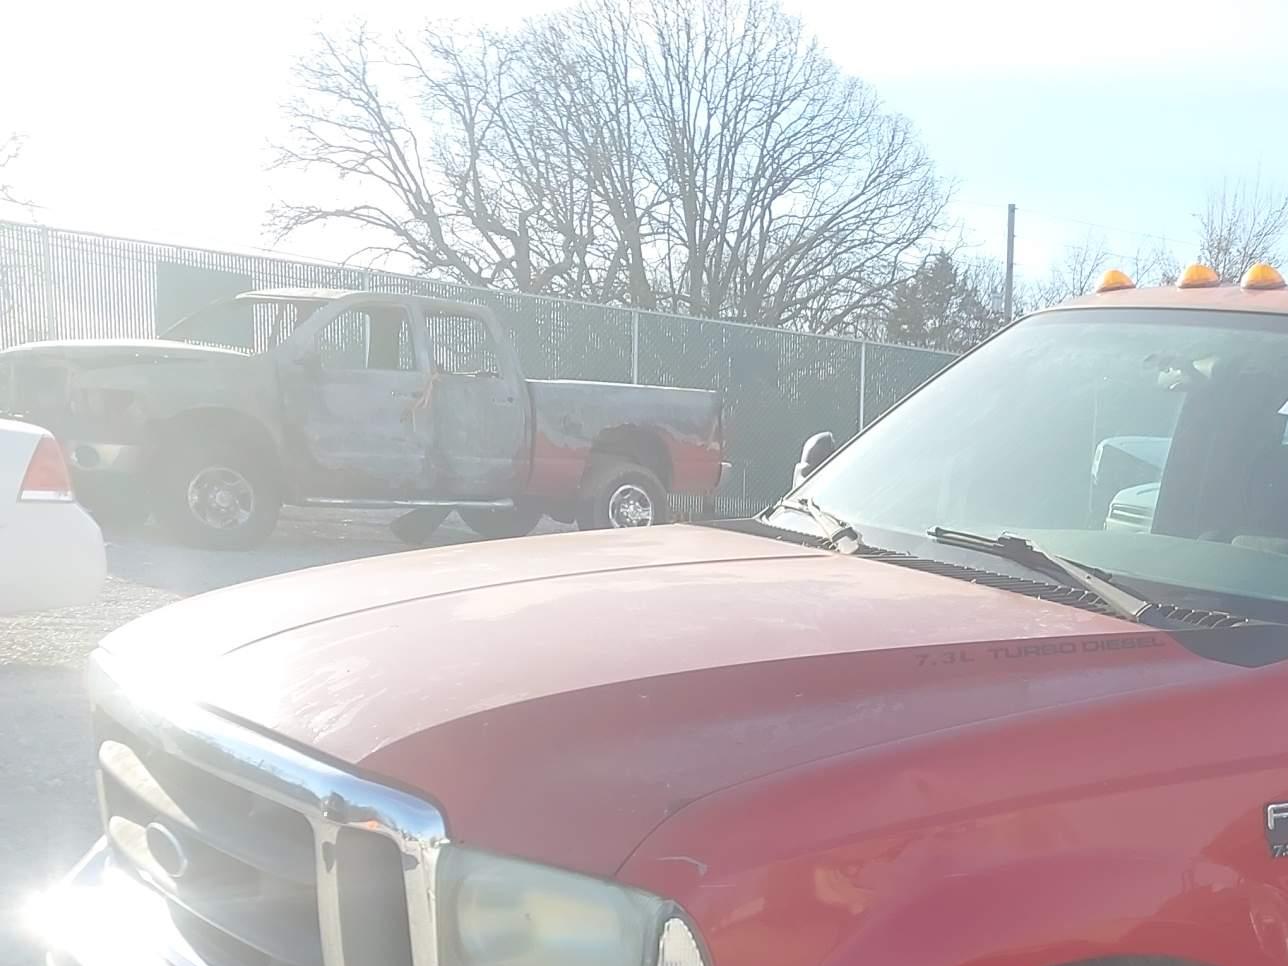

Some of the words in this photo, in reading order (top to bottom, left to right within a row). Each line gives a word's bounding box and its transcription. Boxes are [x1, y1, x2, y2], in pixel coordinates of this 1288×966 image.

[914, 650, 976, 667] 7.3L
[988, 643, 1077, 660] TURBO
[1081, 637, 1167, 653] DIESEL
